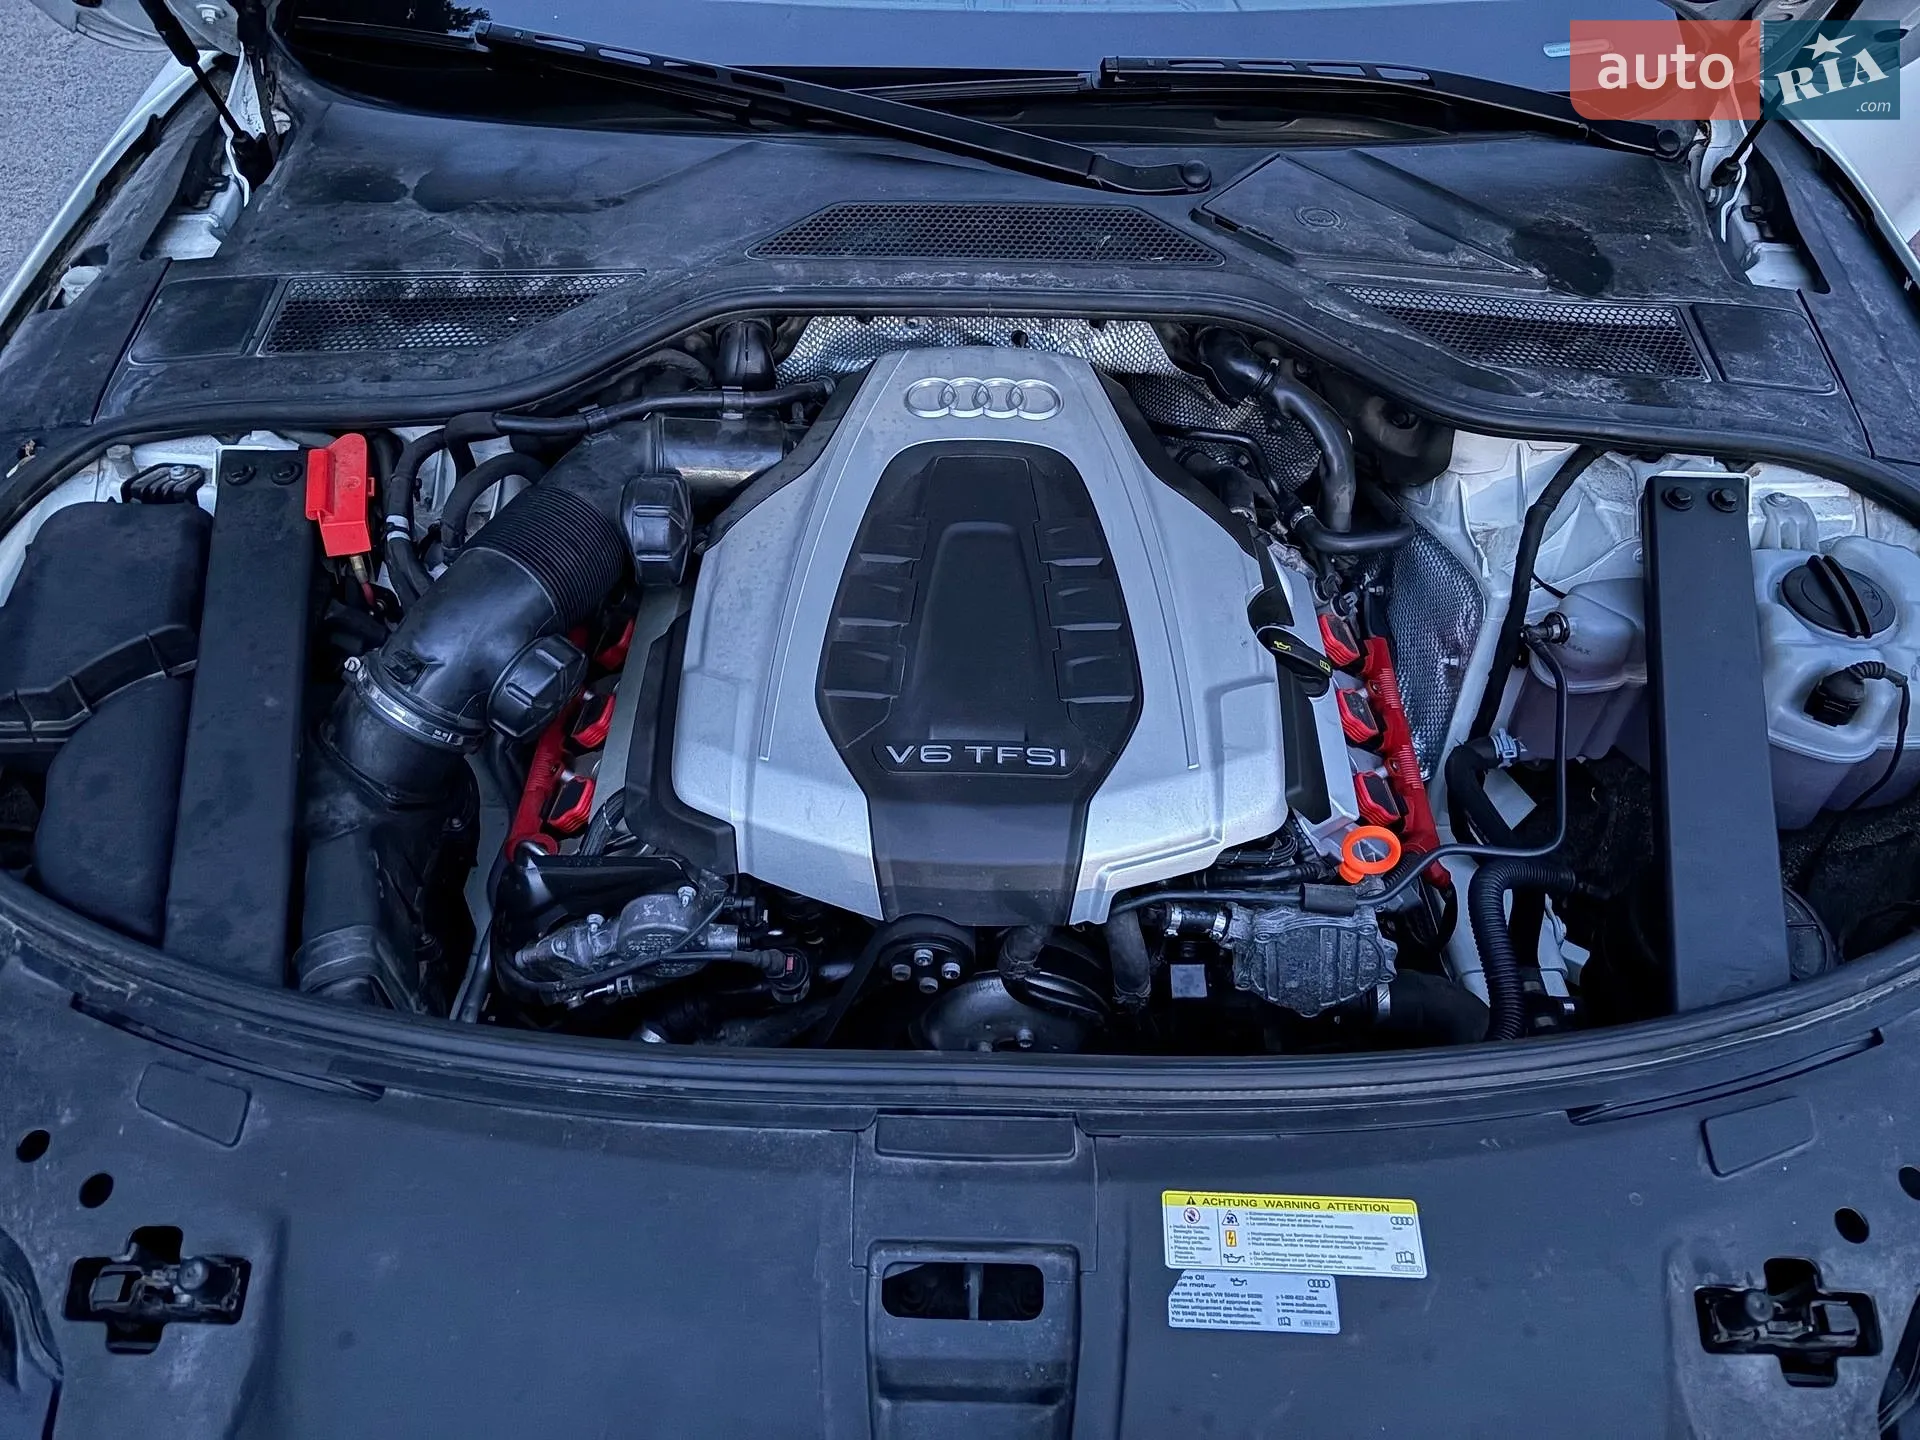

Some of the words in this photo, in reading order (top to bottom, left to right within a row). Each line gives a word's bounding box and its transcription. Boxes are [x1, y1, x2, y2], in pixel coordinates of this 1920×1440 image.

[885, 744, 952, 764] V6
[964, 746, 1066, 767] TFSI
[1202, 1197, 1258, 1208] ACHTUNG
[1263, 1199, 1321, 1210] WARNING
[1327, 1202, 1390, 1212] ATTENTION
